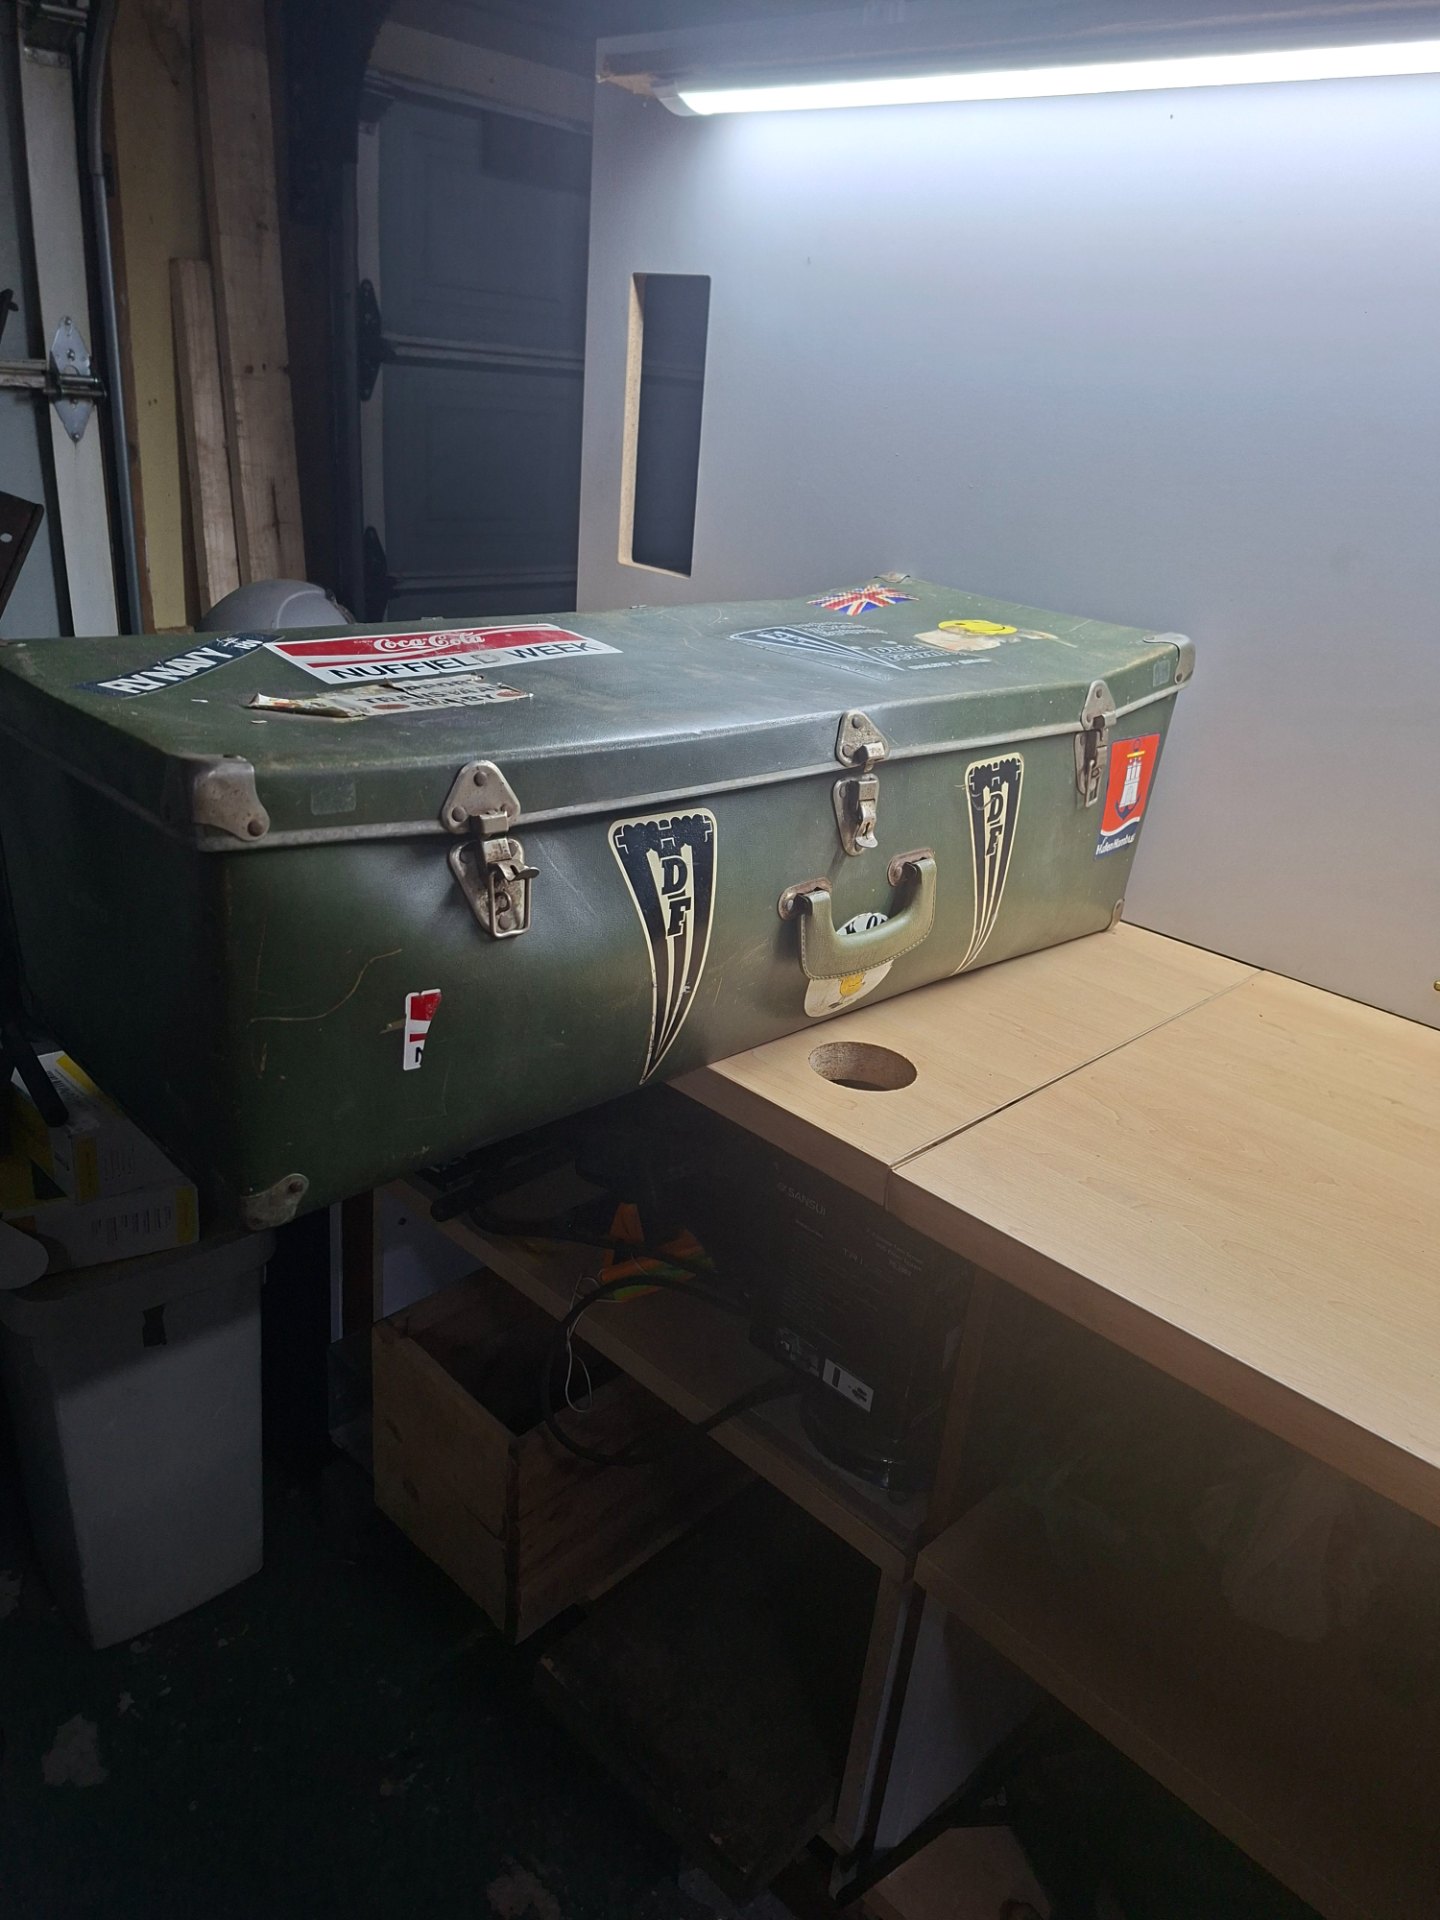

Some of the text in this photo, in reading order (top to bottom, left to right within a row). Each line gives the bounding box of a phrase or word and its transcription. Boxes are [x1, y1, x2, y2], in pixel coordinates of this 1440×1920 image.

[329, 654, 500, 679] NUFFIELD
[505, 641, 599, 659] WEEK
[373, 632, 486, 652] Coca-Cola
[97, 647, 233, 694] FLY NAVY
